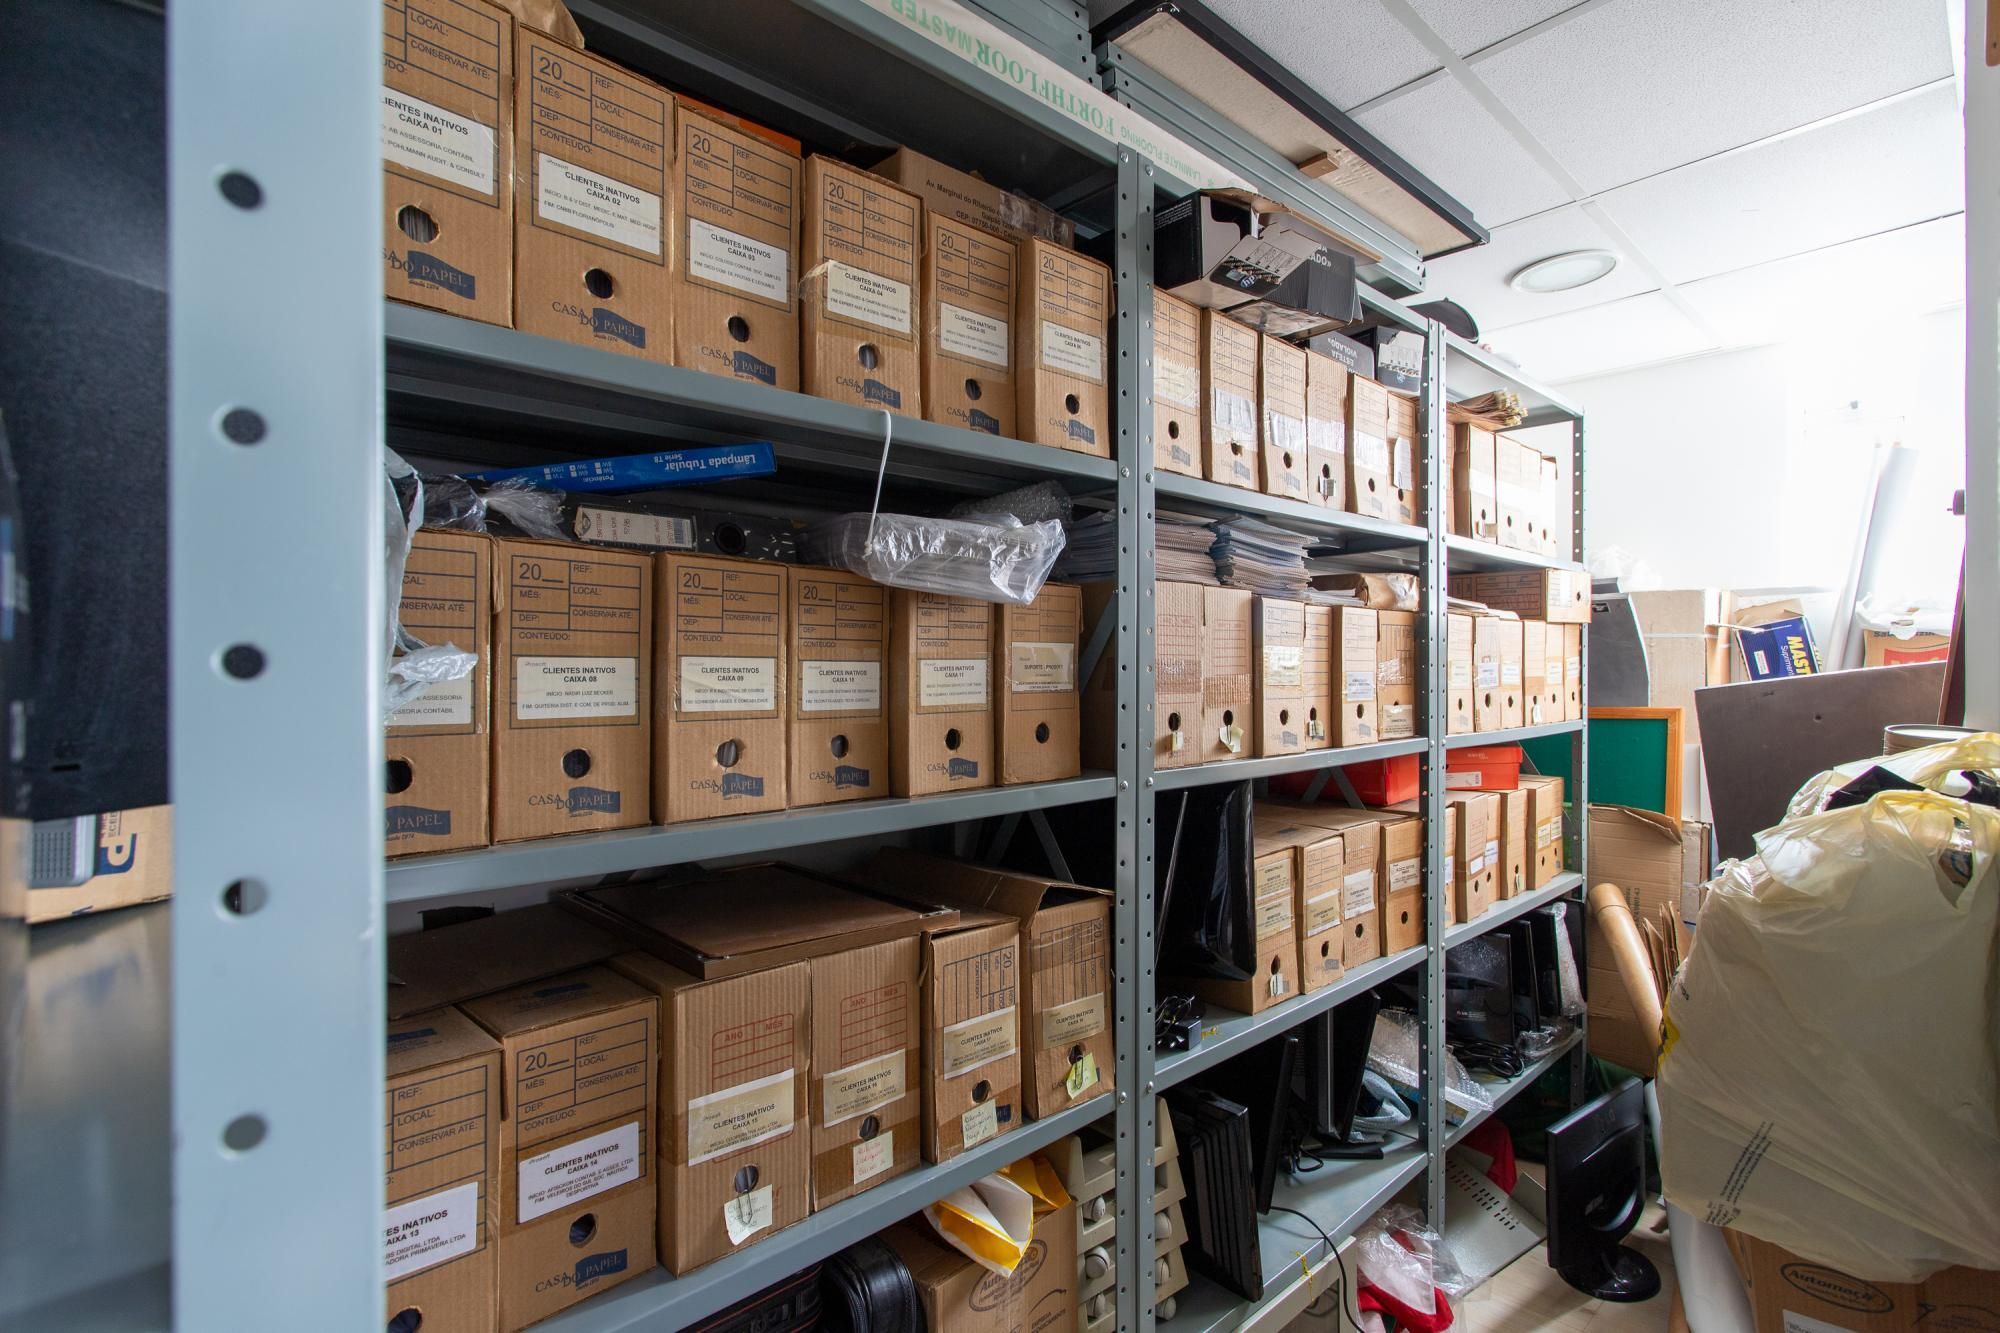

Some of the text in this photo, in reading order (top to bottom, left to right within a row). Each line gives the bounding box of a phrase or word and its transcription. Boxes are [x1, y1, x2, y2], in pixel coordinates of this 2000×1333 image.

[410, 12, 449, 36] LOCAL:
[410, 39, 468, 71] CONSERVAR
[595, 76, 614, 90] REF:
[384, 96, 469, 136] IENTES INATIVOS
[595, 99, 625, 118] LOCAL:
[398, 113, 442, 136] CAIXA 01
[400, 131, 442, 151] ASSESSORIA
[539, 126, 593, 156] CONTEÚDO:
[594, 121, 640, 148] CONSERVAR
[735, 169, 760, 185] LOCAL:
[565, 171, 641, 205] CLIENTES INATIVOS
[586, 187, 621, 207] CAIXA 02
[937, 184, 963, 202] Marginal
[692, 196, 734, 217] CONTEÚDO:
[735, 189, 772, 209] CONSERVAR
[710, 233, 771, 259] CLIENTES INATIVOS
[727, 247, 747, 259] CAIXA
[420, 263, 468, 289] PAPEL
[844, 272, 897, 294] CLIENTES INATIVOS
[859, 284, 876, 295] CAIXA
[552, 301, 639, 339] CASA DO PAPEL
[954, 313, 977, 325] CLIENTES
[701, 346, 727, 360] CASA
[742, 358, 770, 377] PAPEL
[836, 375, 897, 401] CASA PAPEL
[947, 406, 966, 418] CASA
[663, 452, 757, 473] Lâmpada Tubular
[573, 564, 592, 574] REF:
[519, 588, 541, 599] MÊS:
[573, 587, 602, 596] LOCAL:
[519, 613, 540, 623] DEP:
[572, 608, 617, 619] CONSERVAR
[725, 613, 760, 623] CONSERVAR
[519, 630, 571, 641] CONTEÚDO:
[683, 633, 723, 643] CONTEÚDO:
[1786, 635, 1813, 676] MAST
[542, 666, 616, 674] CLIENTES INATIVOS
[563, 675, 598, 683] CAIXA 08
[701, 667, 731, 675] CLIENTES
[422, 694, 463, 702] ASSESSORIA
[690, 778, 717, 791] CASA
[729, 778, 759, 791] PAPEL
[810, 770, 866, 782] CASA PAPEL
[528, 793, 615, 811] CASA DO PAPEL
[397, 811, 443, 830] PAPEL
[579, 1034, 599, 1047] REF:
[724, 1030, 743, 1042] ANO
[961, 1034, 988, 1046] CLIENTES
[579, 1054, 608, 1068] LOCAL:
[578, 1072, 623, 1090] CONSERVAR
[840, 1069, 892, 1093] CLIENTES INATIVOS
[856, 1086, 871, 1094] CAIXA
[398, 1086, 423, 1102] REF:
[397, 1109, 436, 1128] LOCAL:
[524, 1109, 576, 1132] CONTEÚDO:
[713, 1103, 775, 1129] CLIENTES INATIVOS
[732, 1120, 751, 1131] CAIXA
[397, 1122, 478, 1152] CONSERVAR ATÉ:
[544, 1143, 619, 1176] CLIENTES INATIVOS
[567, 1159, 598, 1175] CAIXA 14
[402, 1209, 448, 1232] INATIVOS
[386, 1228, 420, 1246] AIXA 13
[410, 1232, 467, 1258] PRIMAVERA LTDA
[423, 1235, 441, 1246] LTDA
[535, 1255, 622, 1293] CASA DO PAPEL
